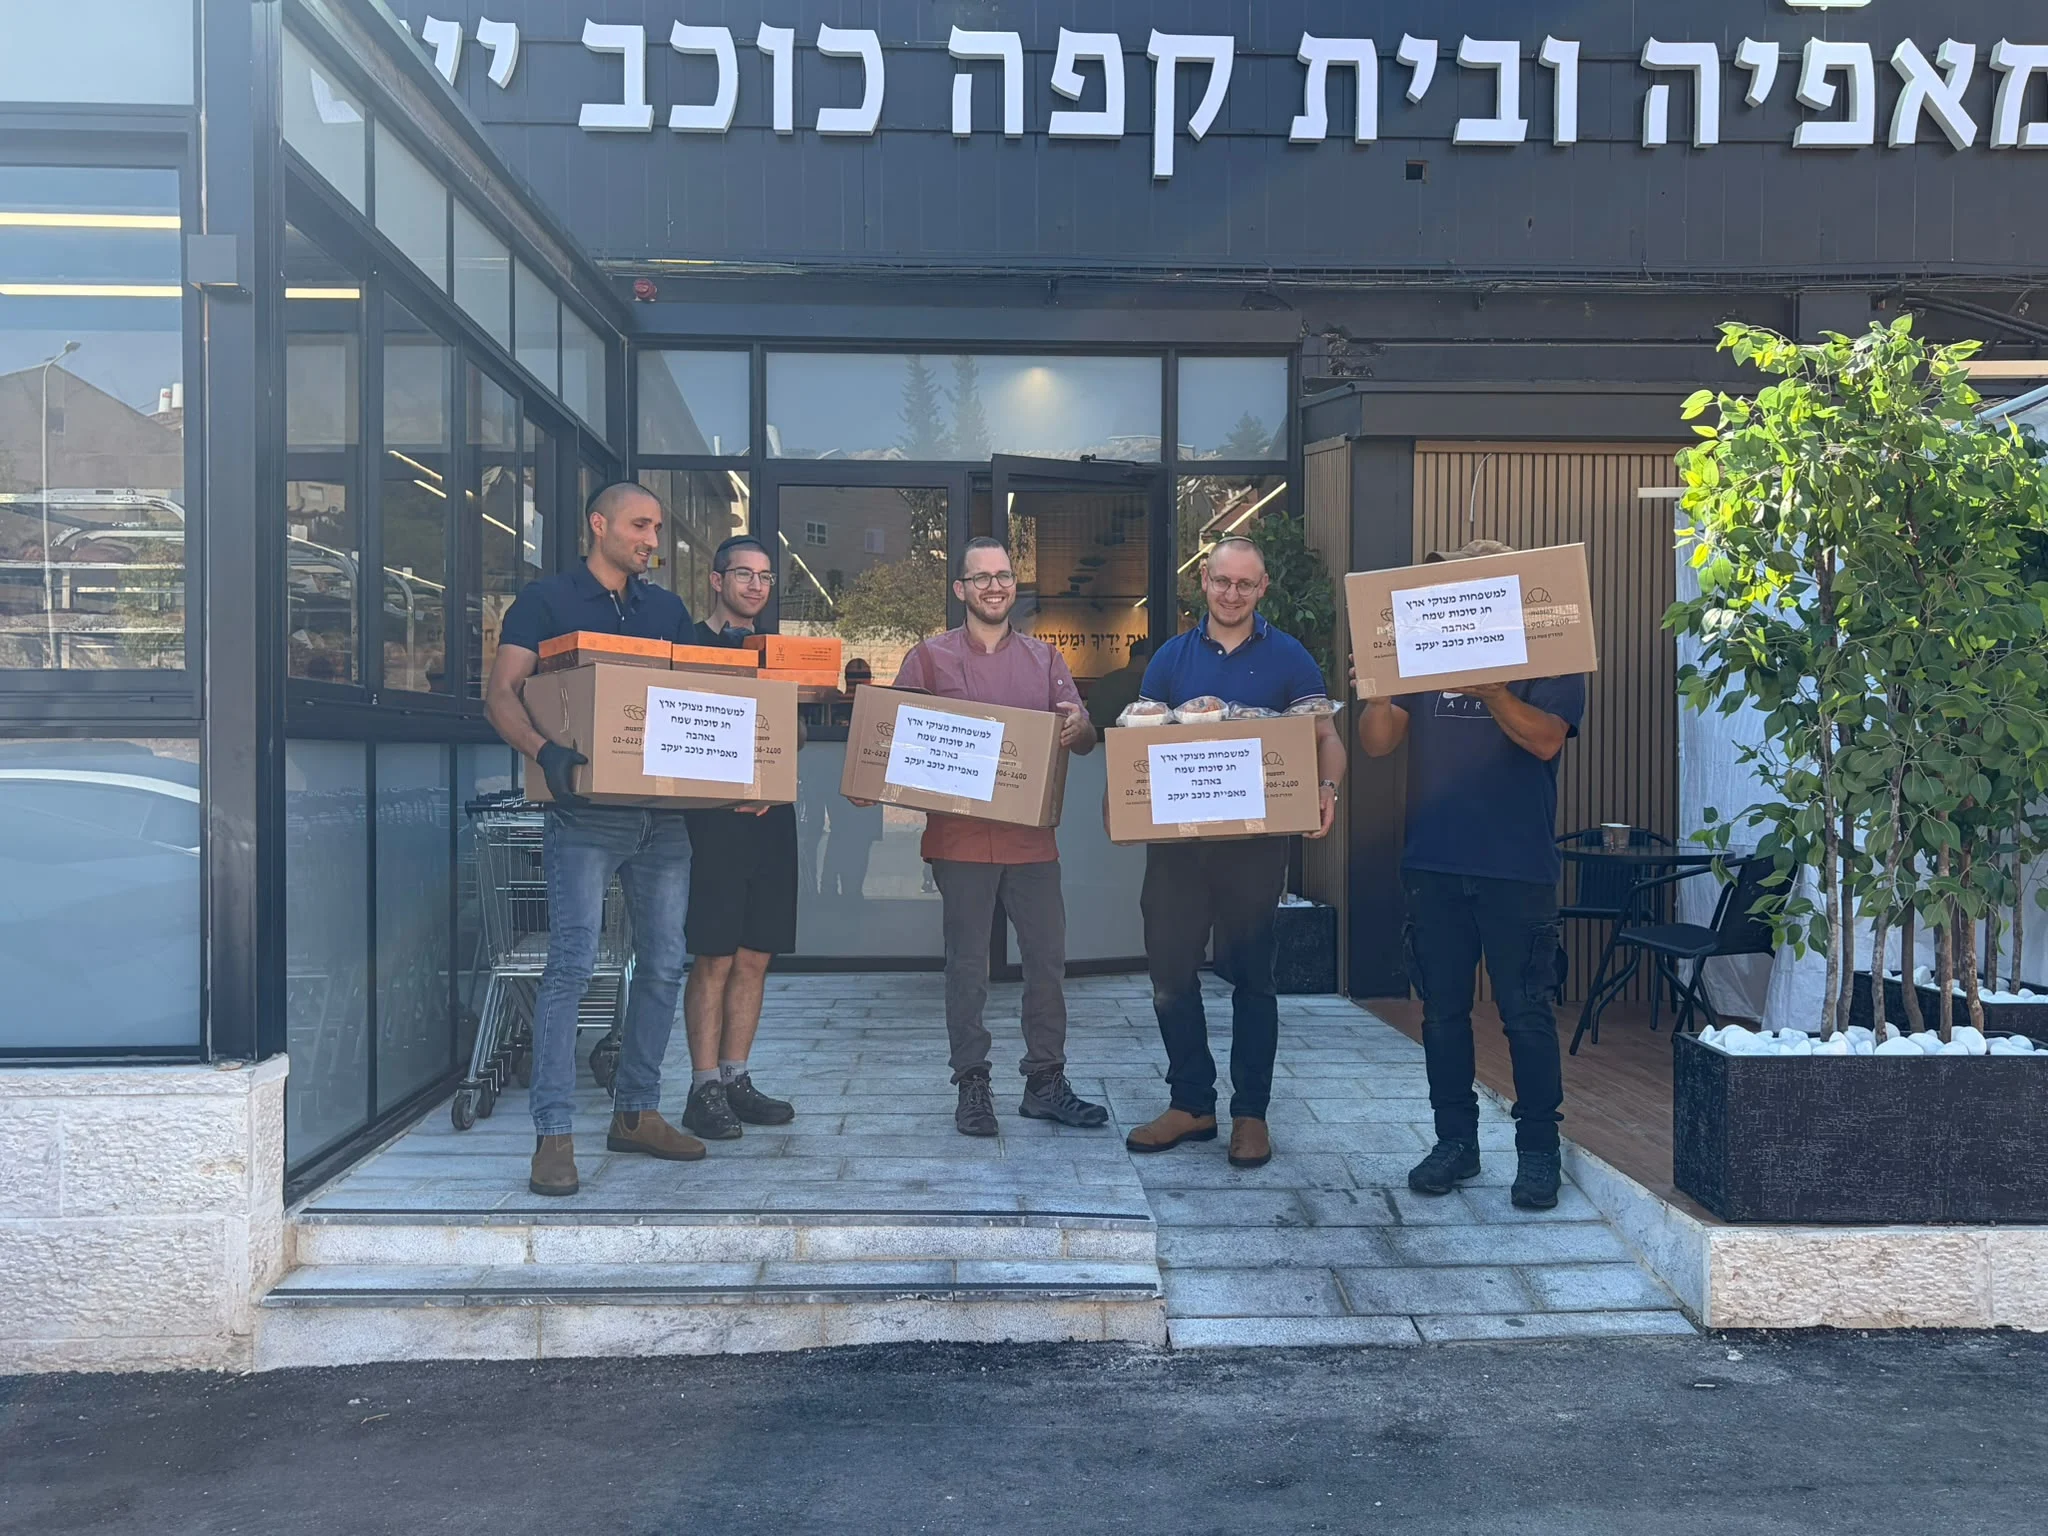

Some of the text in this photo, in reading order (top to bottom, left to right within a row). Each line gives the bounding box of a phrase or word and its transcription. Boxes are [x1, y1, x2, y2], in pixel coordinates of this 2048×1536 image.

[578, 18, 886, 136] כוכב
[1289, 31, 1580, 147] ובית
[1642, 35, 2048, 151] מאפיה
[948, 24, 1234, 180] קפה
[1405, 588, 1507, 610] למשפחות מצוקי ארץ
[1422, 605, 1492, 621] חג סוכות שמח
[1441, 622, 1476, 633] באהבה
[1415, 633, 1505, 652] מאפיית כוכב יעקב
[659, 699, 745, 717] למשפחות מצוקי ארץ
[1447, 700, 1482, 710] AIR
[670, 715, 731, 729] חג סוכות שמח
[907, 717, 992, 739] למשפחות מצוקי ארץ
[685, 731, 716, 742] באהבה
[917, 732, 976, 749] חג סוכות שמח
[660, 743, 738, 758] מאפיית כוכב יעקב
[929, 748, 959, 760] באהבה
[1160, 748, 1250, 763] למשפחות מצוקי ארץ
[904, 756, 979, 777] מאפיית כוכב יעקב
[1174, 763, 1237, 774] חג סוכות שמח
[1191, 777, 1222, 786] באהבה
[1167, 789, 1247, 802] מאפיית כוכב יעקב
